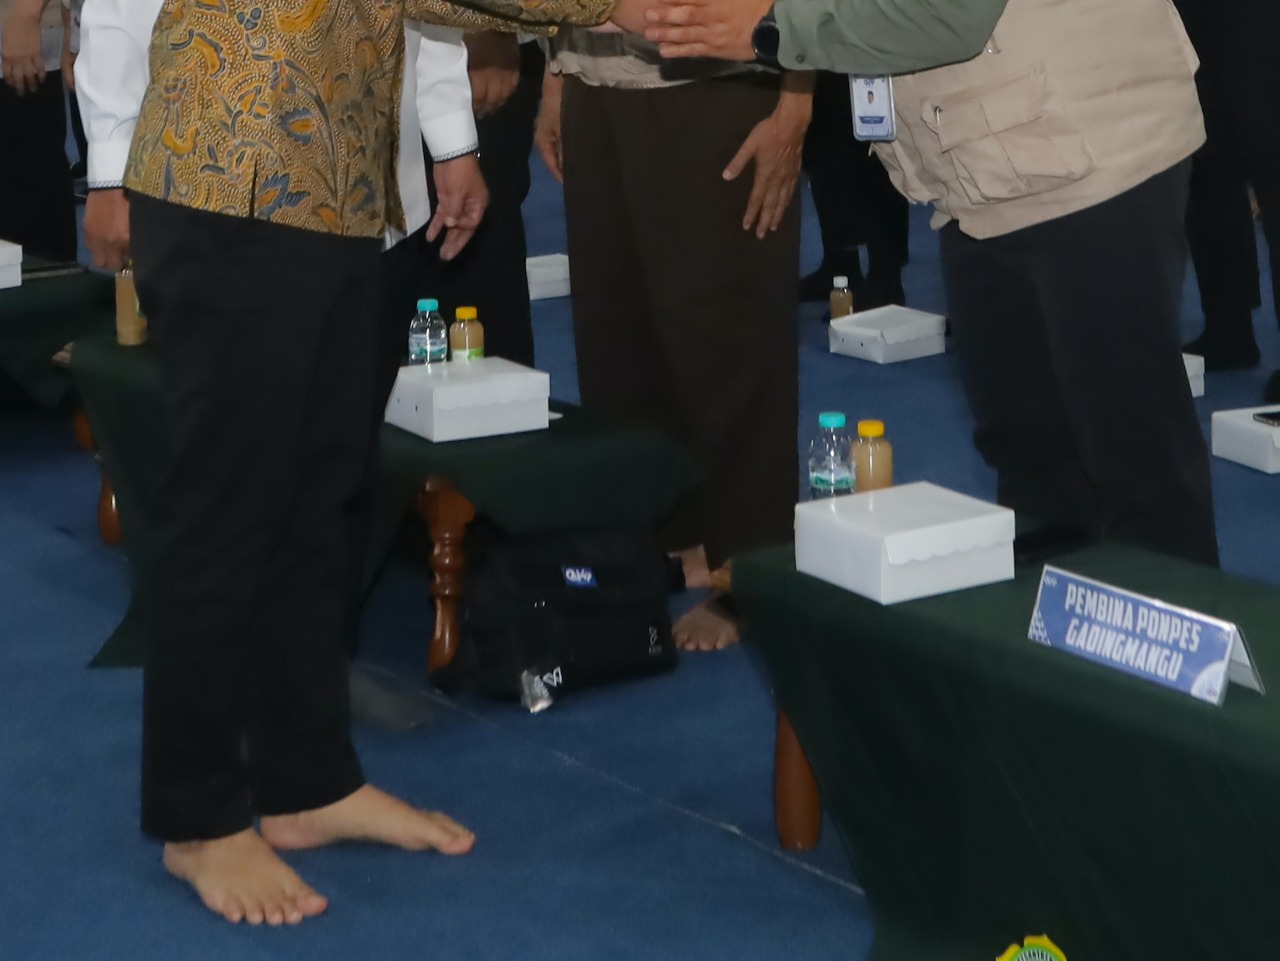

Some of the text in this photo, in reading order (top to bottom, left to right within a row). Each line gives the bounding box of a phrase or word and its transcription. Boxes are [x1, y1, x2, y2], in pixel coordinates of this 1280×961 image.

[1065, 582, 1202, 653] PEMBINA PONPES
[1065, 618, 1183, 681] GADINGMANGU
